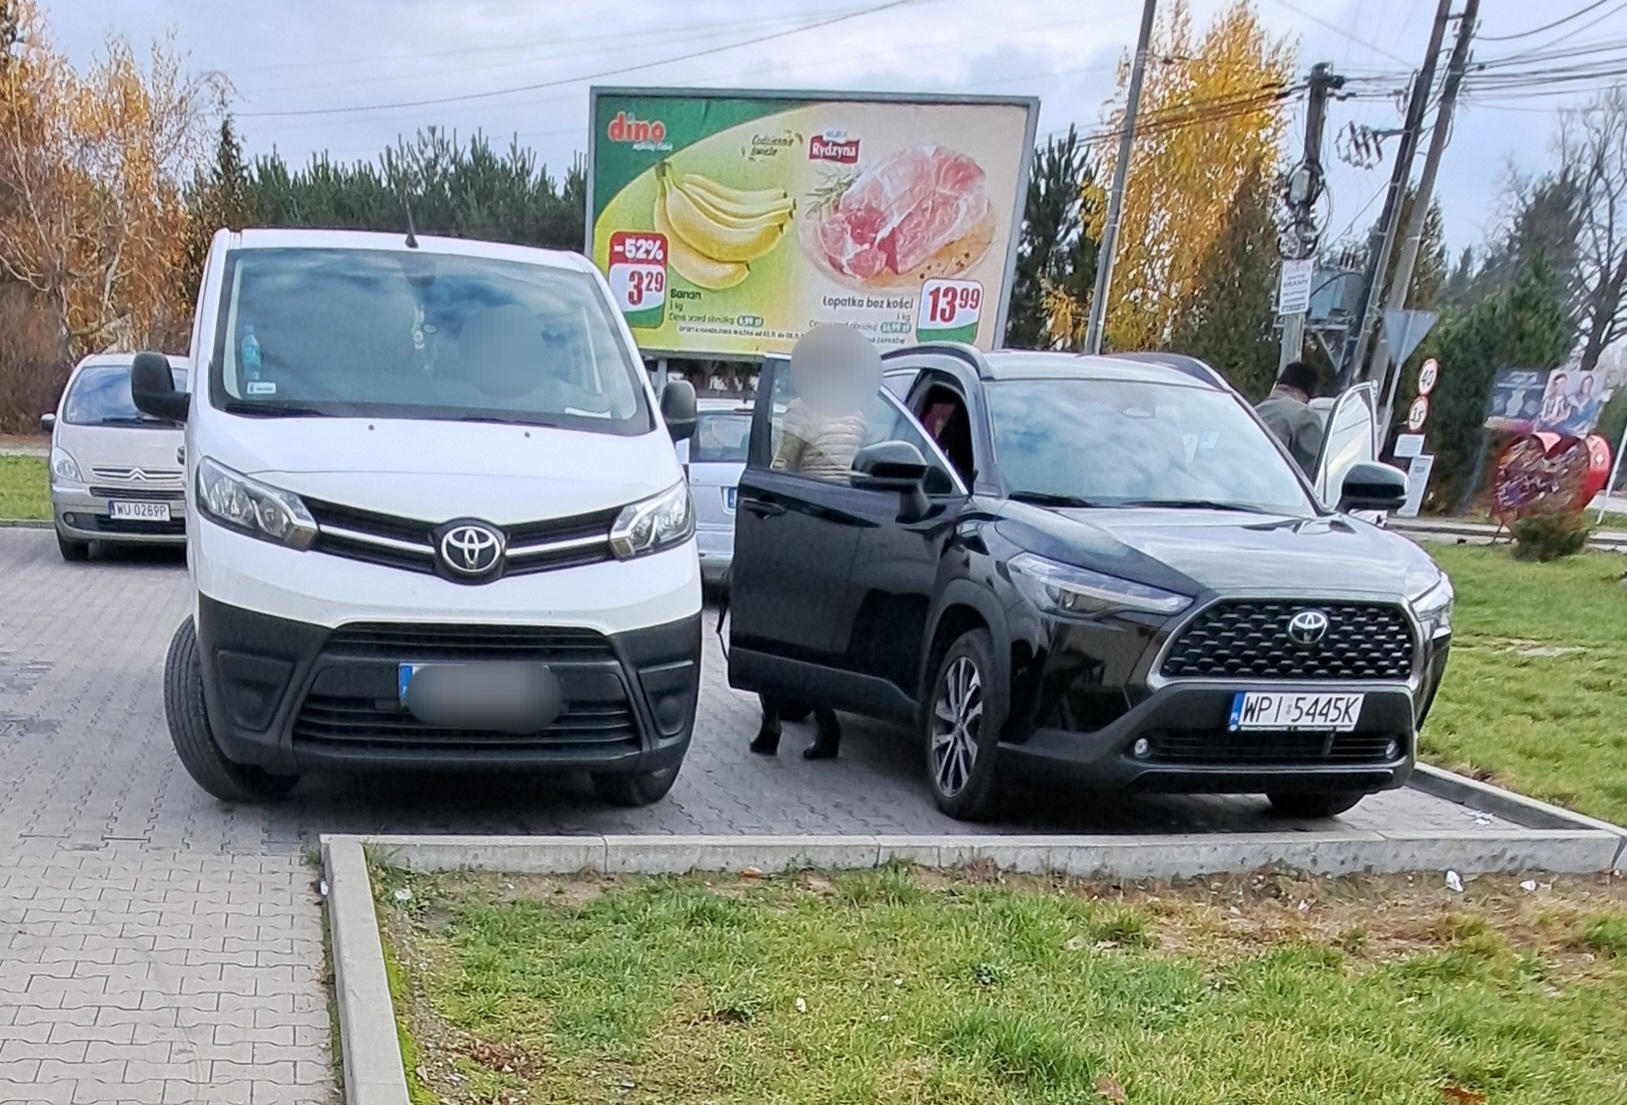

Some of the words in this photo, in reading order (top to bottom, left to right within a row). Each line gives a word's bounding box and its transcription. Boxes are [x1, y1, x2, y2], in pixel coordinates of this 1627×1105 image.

[608, 111, 667, 142] dino
[812, 142, 856, 158] Rydzyna
[613, 237, 664, 260] -52%
[670, 288, 702, 300] Banan
[116, 503, 131, 516] WU
[1243, 696, 1283, 723] WPI
[1290, 696, 1359, 723] 5445K
